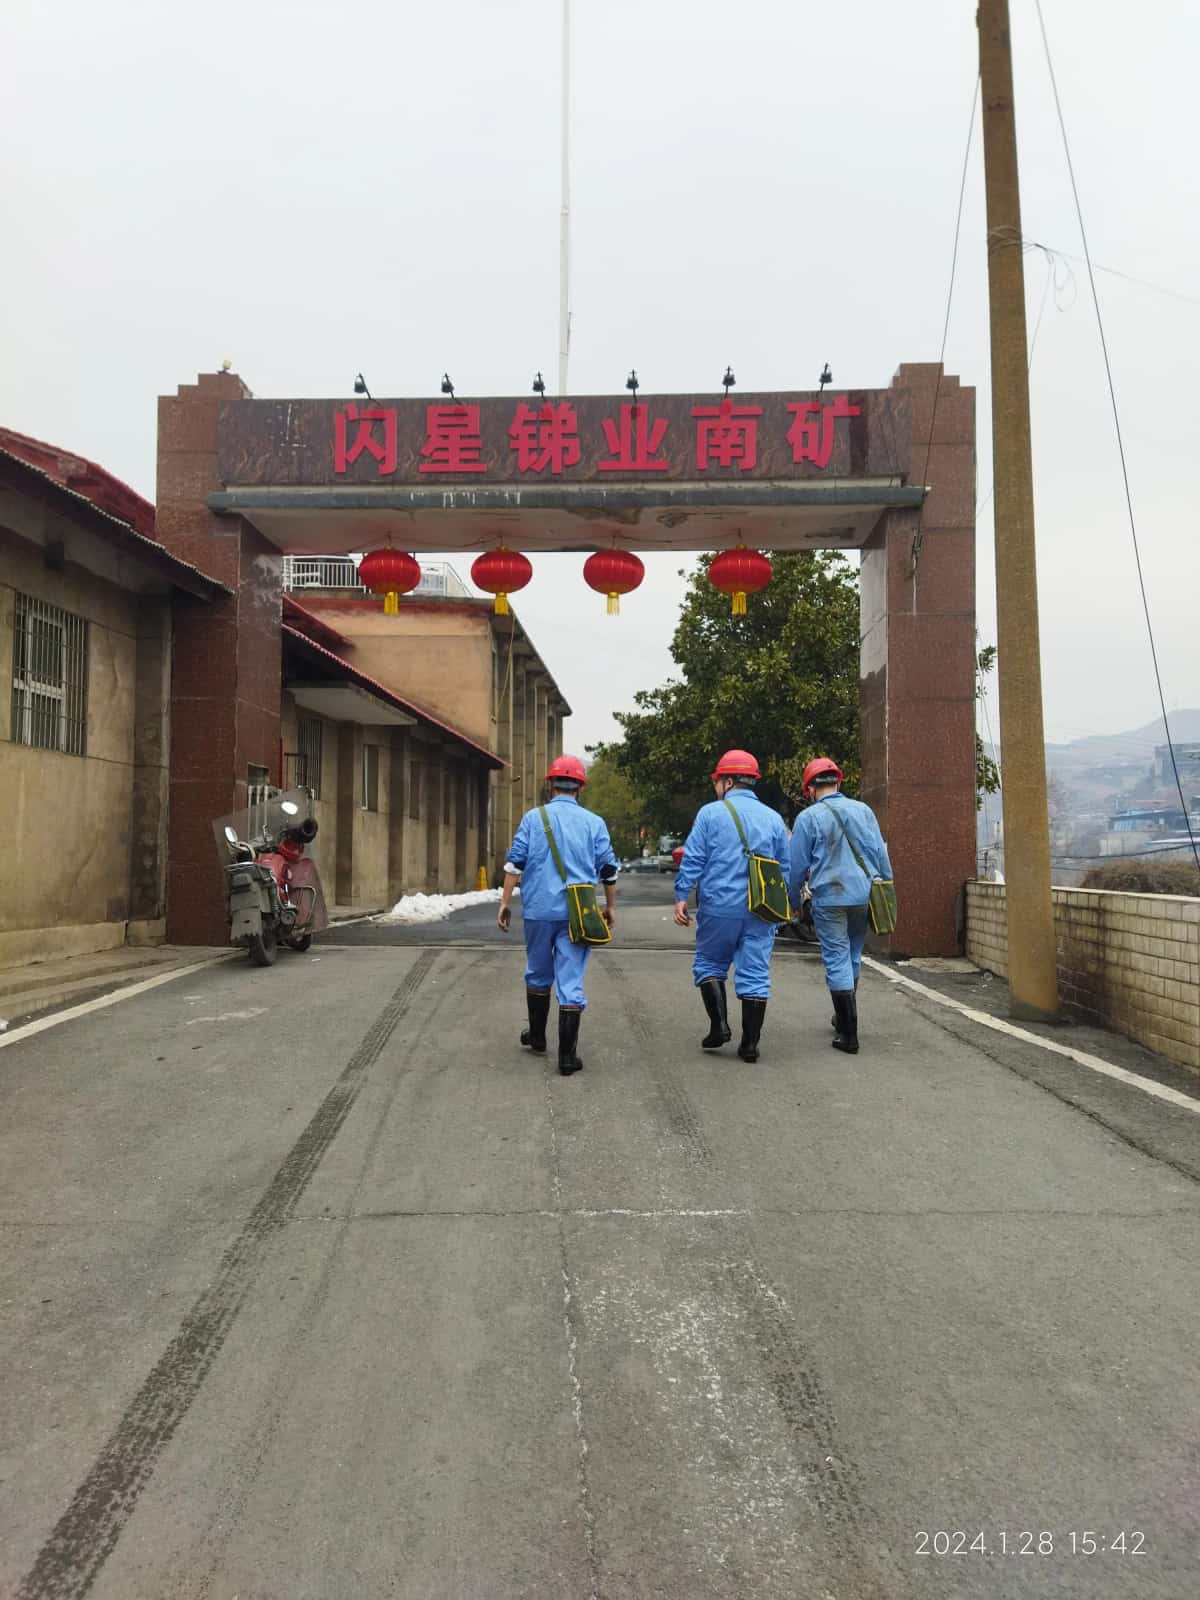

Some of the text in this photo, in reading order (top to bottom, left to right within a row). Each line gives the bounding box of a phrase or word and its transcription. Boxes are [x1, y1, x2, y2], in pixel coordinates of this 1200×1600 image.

[333, 395, 861, 475] 闪星锑业南矿
